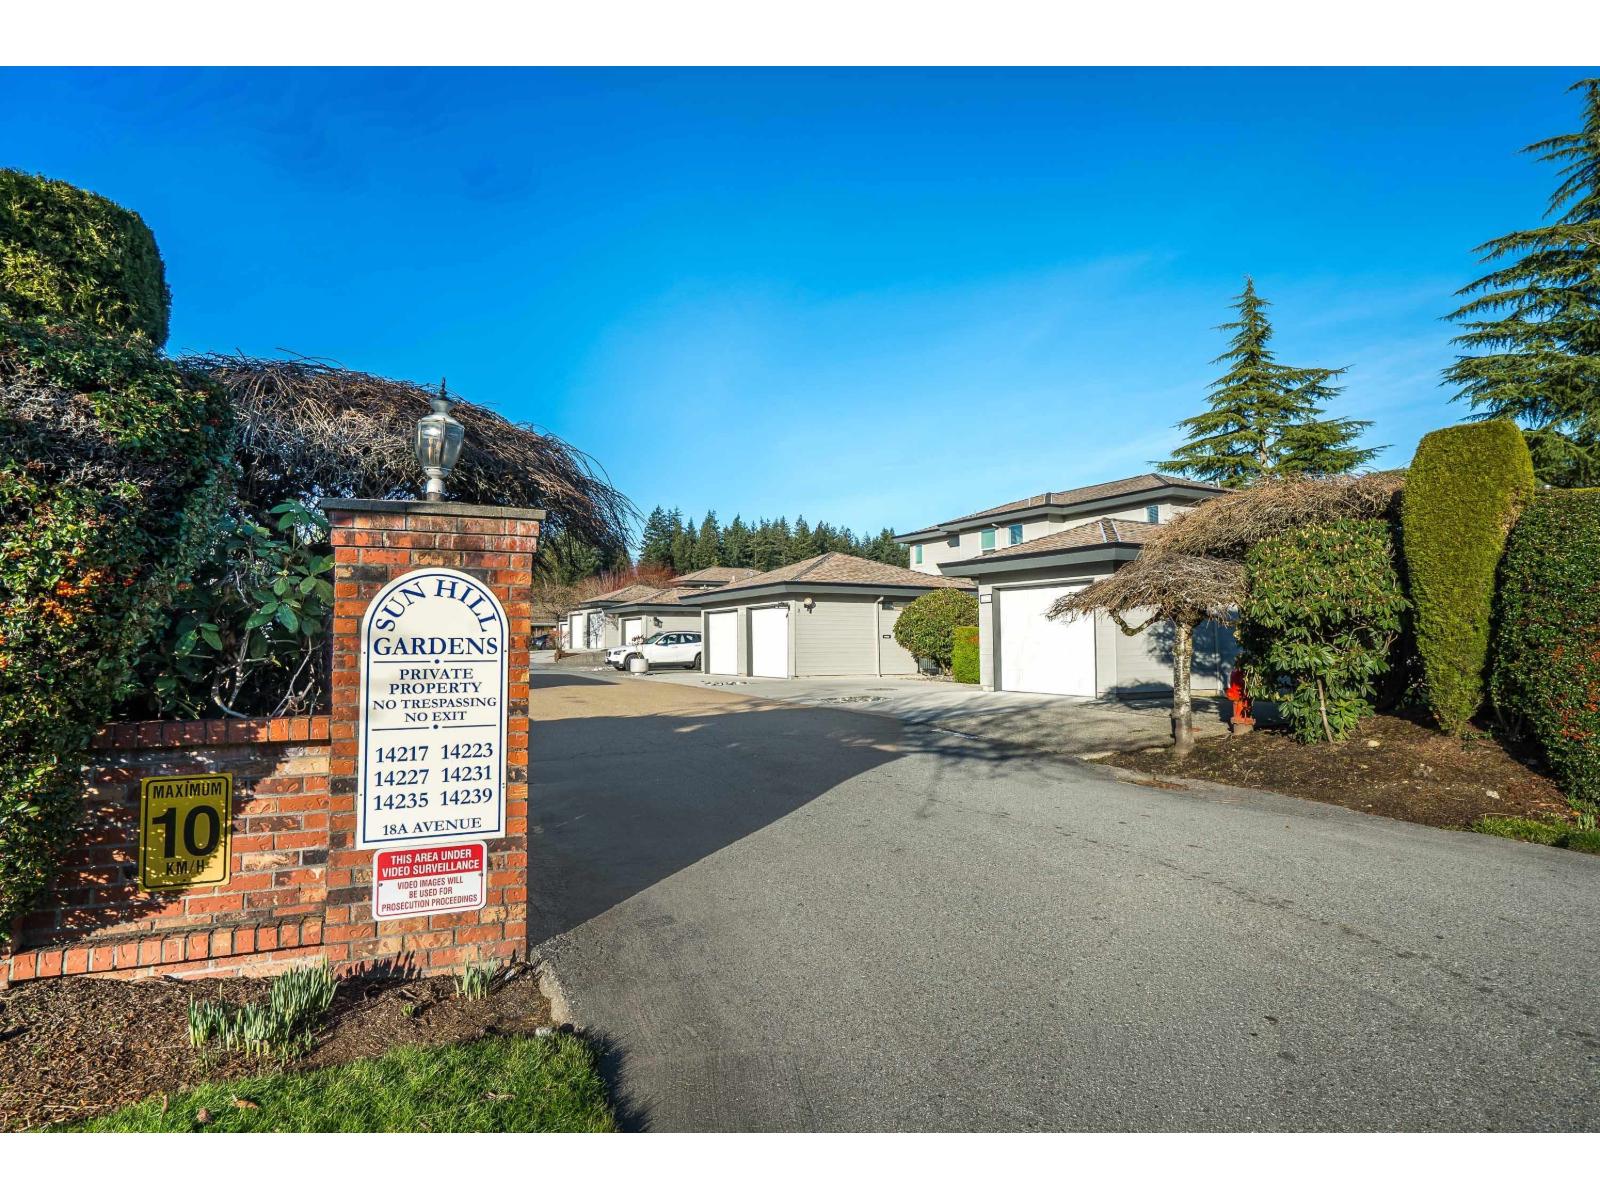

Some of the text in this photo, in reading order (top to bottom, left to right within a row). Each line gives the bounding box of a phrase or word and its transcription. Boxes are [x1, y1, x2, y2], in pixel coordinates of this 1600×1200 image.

[375, 579, 497, 632] SUN HILL
[373, 637, 498, 656] GARDENS
[399, 668, 474, 680] PRIVATE
[388, 681, 483, 695] PROPERTY
[372, 697, 497, 710] NO TRESPASSING
[405, 711, 467, 722] NO EXIT
[375, 742, 494, 763] 14217 14223
[374, 765, 492, 787] 14227 14231
[153, 782, 222, 799] MAXIMUM
[373, 787, 493, 811] 14235 14239
[152, 805, 221, 859] 10
[383, 817, 482, 836] 18A AVENUE
[390, 848, 472, 866] THIS AREA UNDER
[166, 859, 205, 876] KM/H
[382, 859, 480, 878] VIDEO SURVEILLANCE
[397, 875, 464, 890] VIDEO IMAGES WILL
[408, 886, 453, 899] BE USED FOR
[381, 894, 478, 912] PROSECUTION PROCEEDINGS
